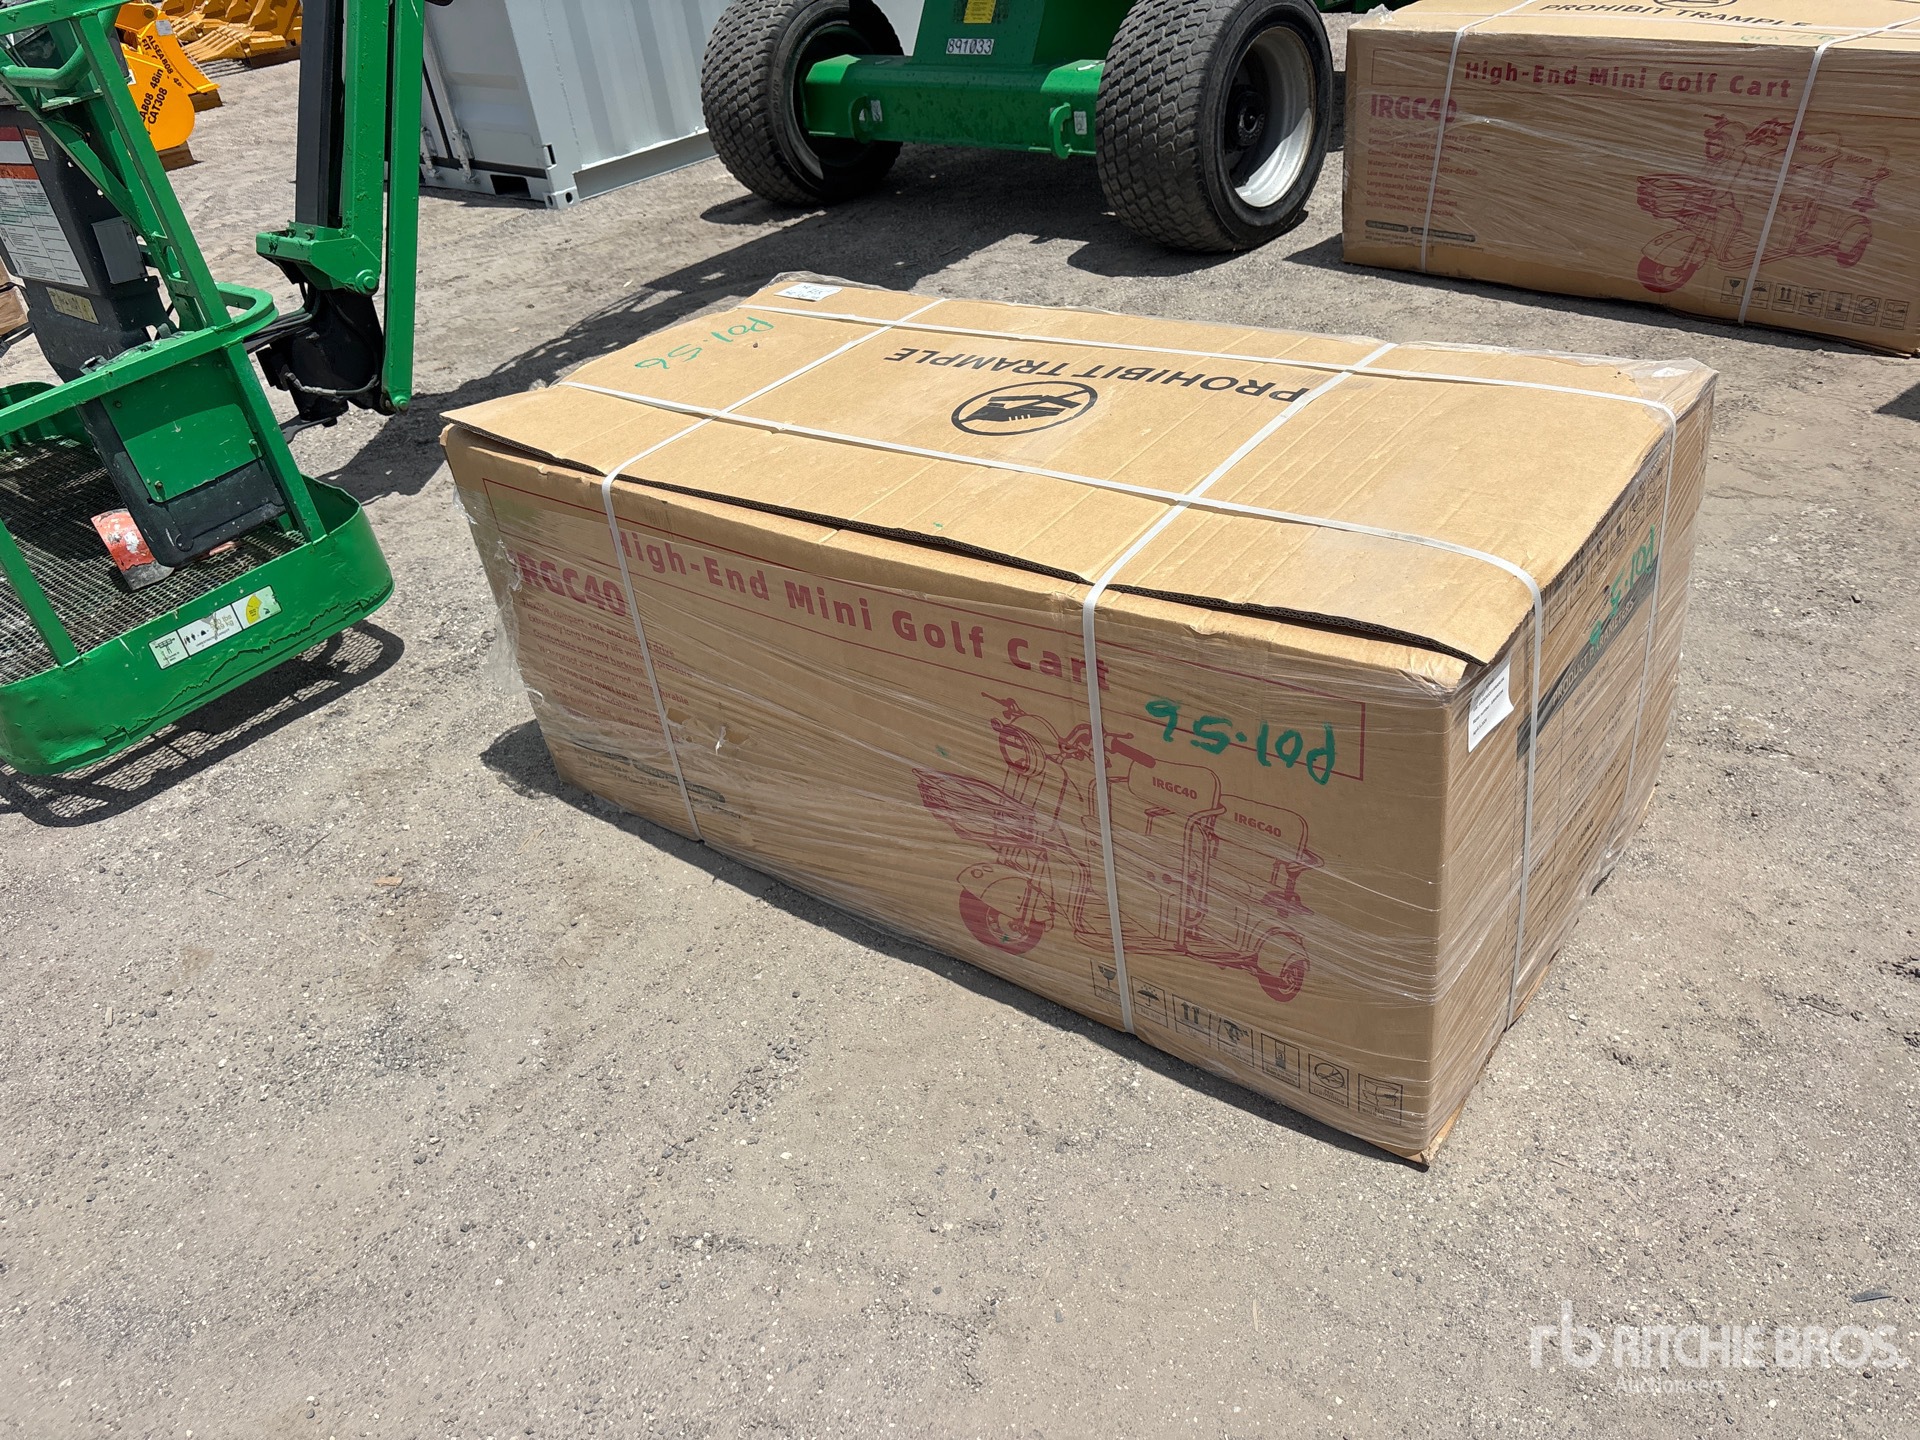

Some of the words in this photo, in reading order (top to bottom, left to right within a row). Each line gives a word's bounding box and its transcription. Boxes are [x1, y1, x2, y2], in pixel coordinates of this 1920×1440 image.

[1539, 3, 1673, 15] PROHIBIT
[142, 38, 152, 50] FIT
[947, 38, 993, 54] 891033
[150, 69, 164, 89] 48in
[1465, 61, 1577, 86] High-End
[1589, 66, 1646, 89] Mini
[1658, 71, 1718, 93] Golf
[1729, 75, 1792, 98] Cart
[147, 87, 168, 125] CAT308
[883, 346, 1071, 378] TRAMPLE
[1070, 364, 1310, 403] PROHIBIT
[784, 579, 872, 631] Mini
[892, 610, 984, 659] Golf
[1552, 652, 1589, 706] PRODUCT
[1152, 776, 1198, 800] IRGC40
[1234, 811, 1282, 838] IRGC40
